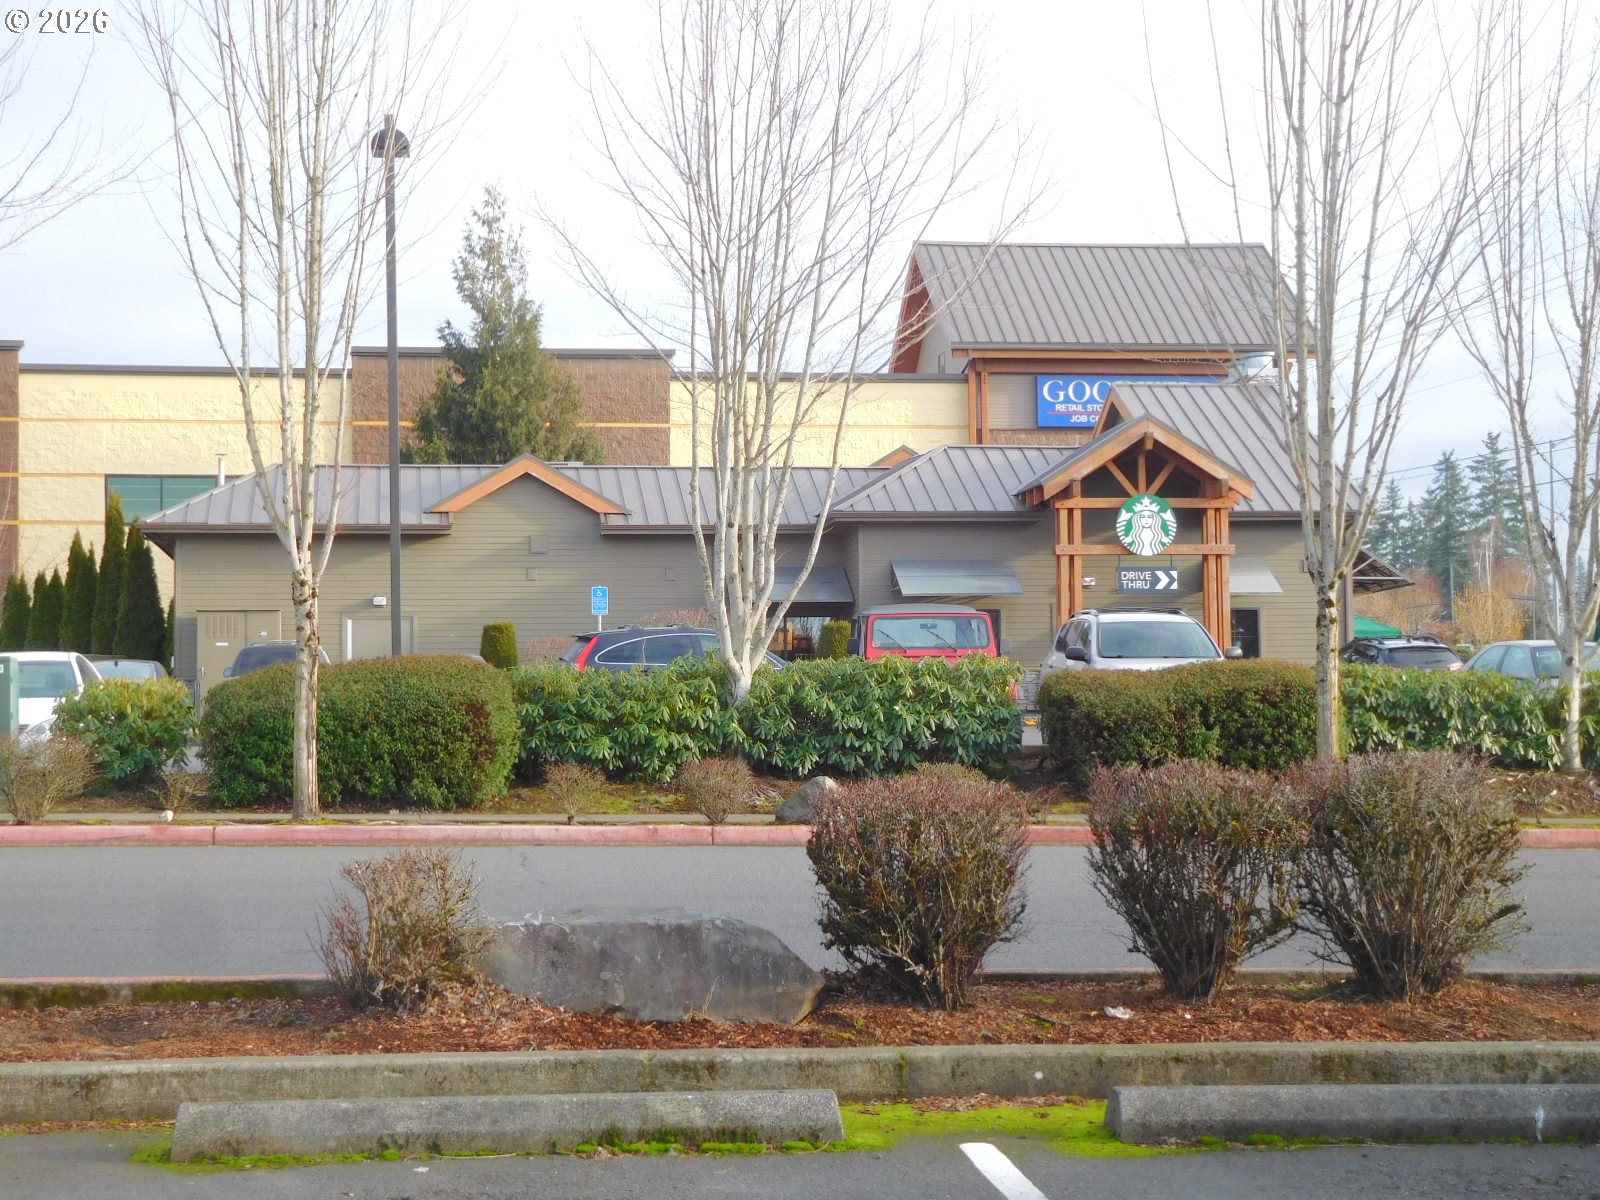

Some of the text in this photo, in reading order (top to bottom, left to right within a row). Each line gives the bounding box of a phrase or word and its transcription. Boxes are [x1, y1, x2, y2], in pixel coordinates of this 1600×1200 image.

[1055, 404, 1085, 412] RETAIL
[1070, 415, 1088, 423] JOB
[1121, 571, 1152, 580] DRIVE
[1121, 580, 1150, 589] THRU
